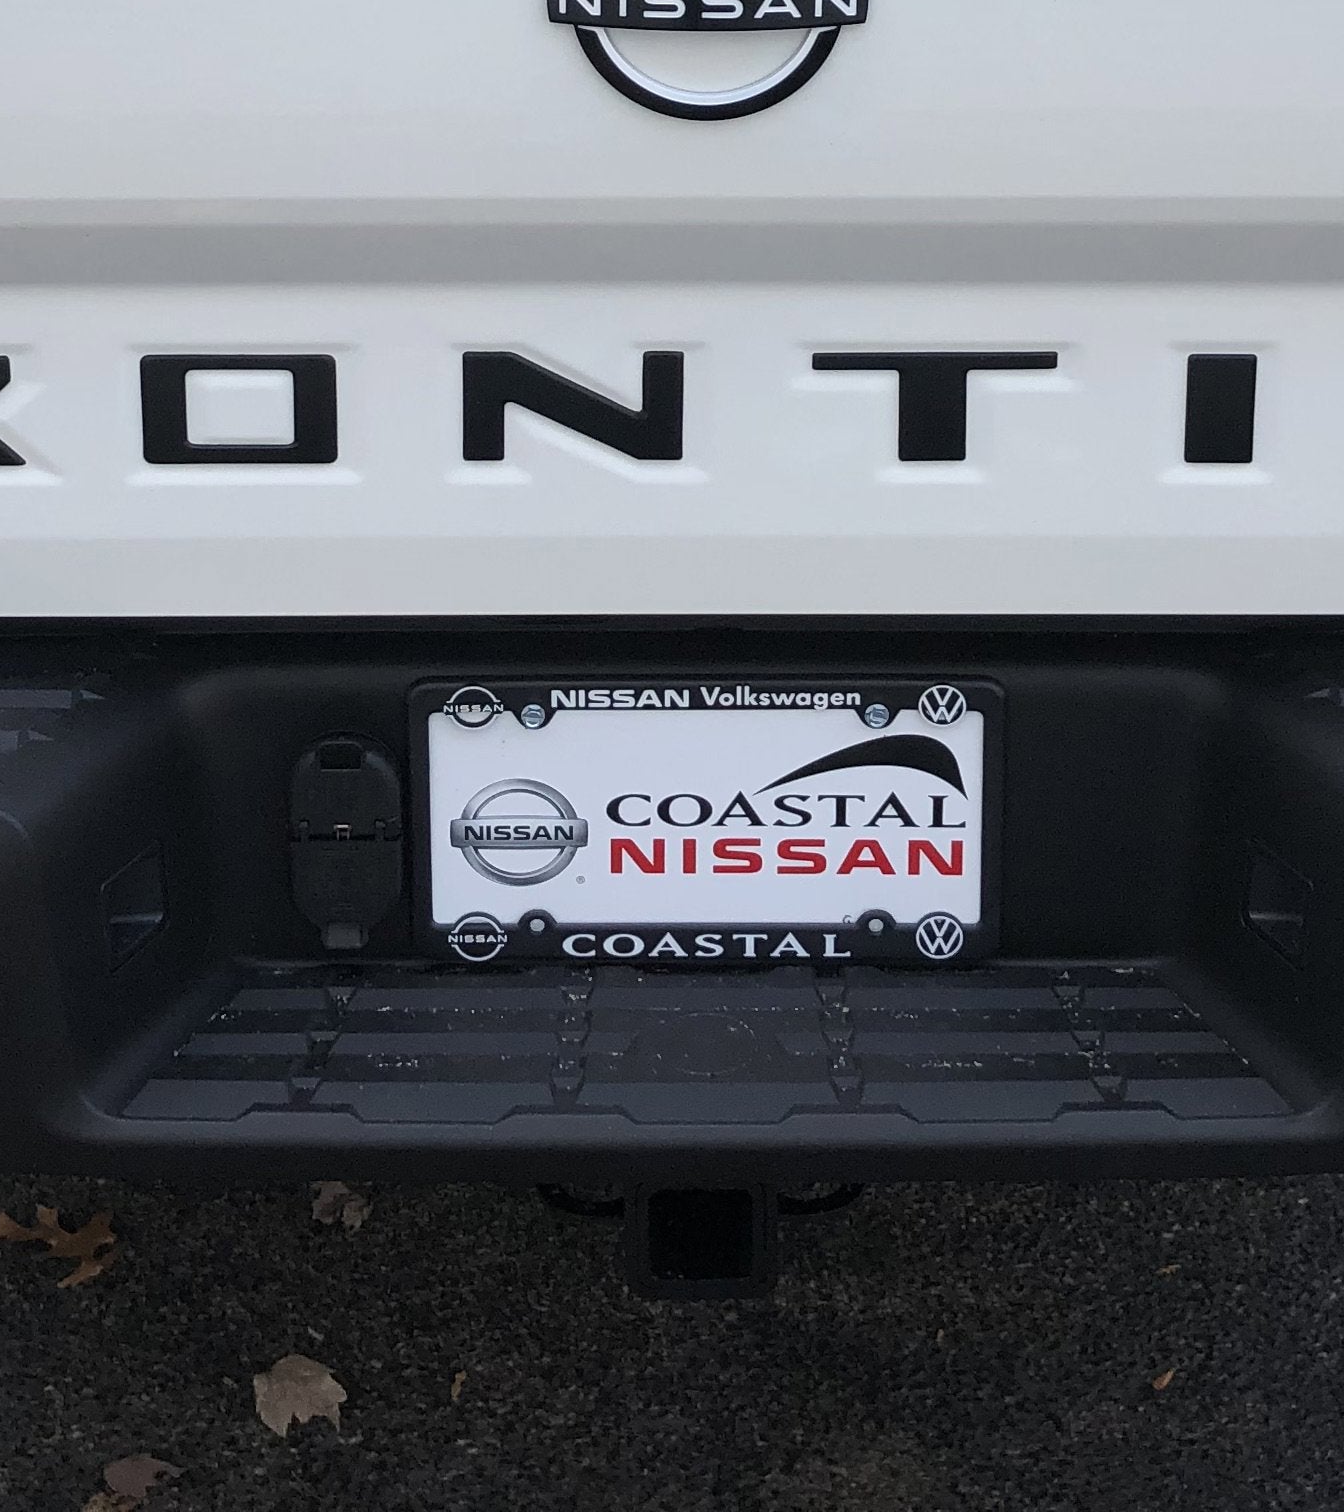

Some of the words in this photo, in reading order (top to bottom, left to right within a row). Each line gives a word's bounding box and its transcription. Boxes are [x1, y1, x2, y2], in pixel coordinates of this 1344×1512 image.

[443, 703, 504, 713] NISSAN
[550, 688, 690, 709] NISSAN
[700, 685, 861, 710] Volkswagen
[605, 791, 966, 828] COASTAL
[463, 824, 575, 841] NISSAN
[609, 838, 964, 877] NISSAN
[447, 934, 508, 943] NISSAN
[561, 932, 852, 959] COASTAL
